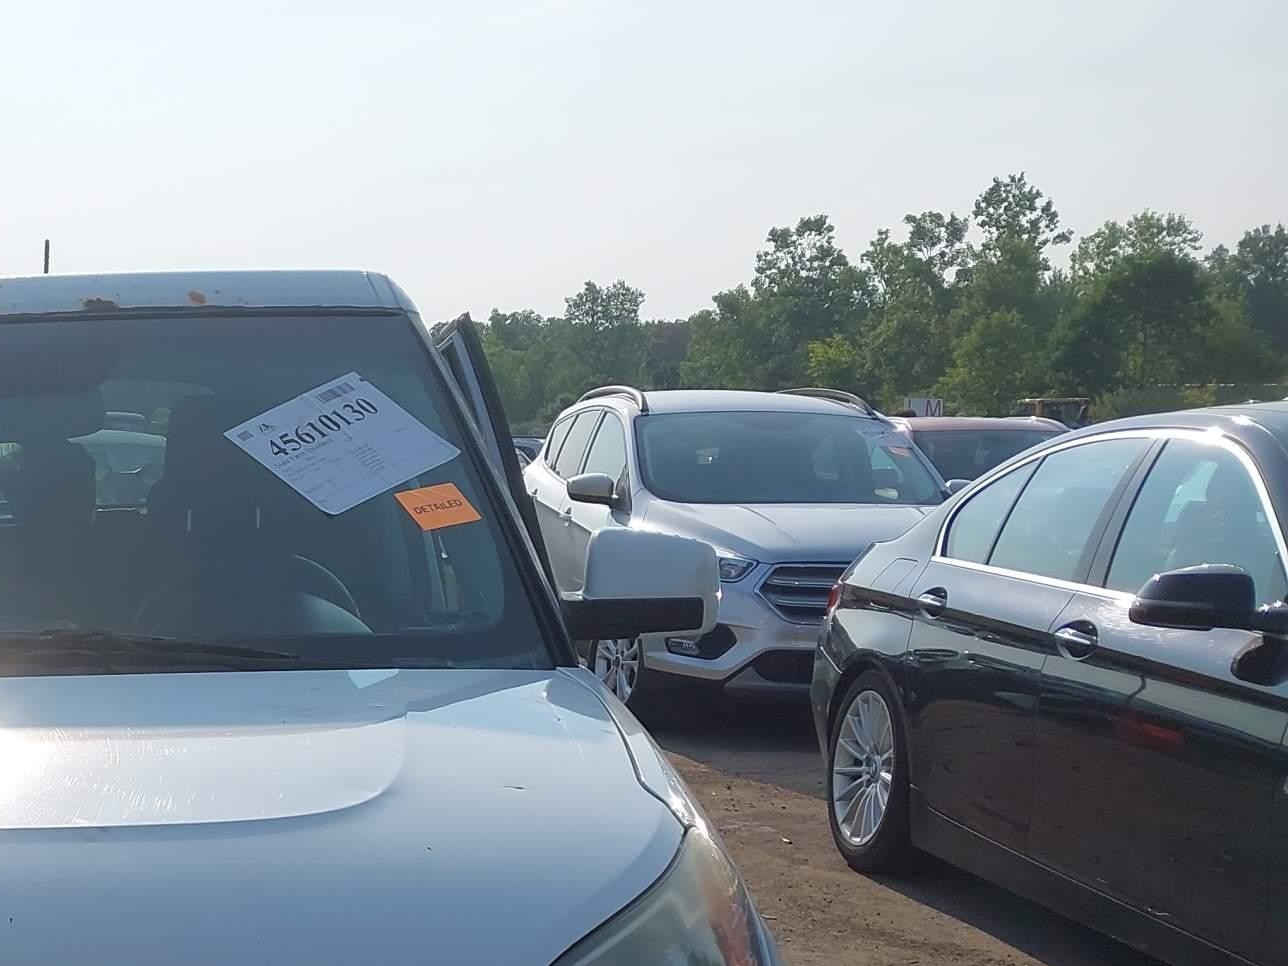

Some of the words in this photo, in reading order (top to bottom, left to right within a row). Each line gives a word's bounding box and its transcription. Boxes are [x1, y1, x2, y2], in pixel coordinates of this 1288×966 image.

[926, 399, 941, 417] M
[268, 397, 378, 459] 45610130
[412, 498, 463, 515] DETAILED
